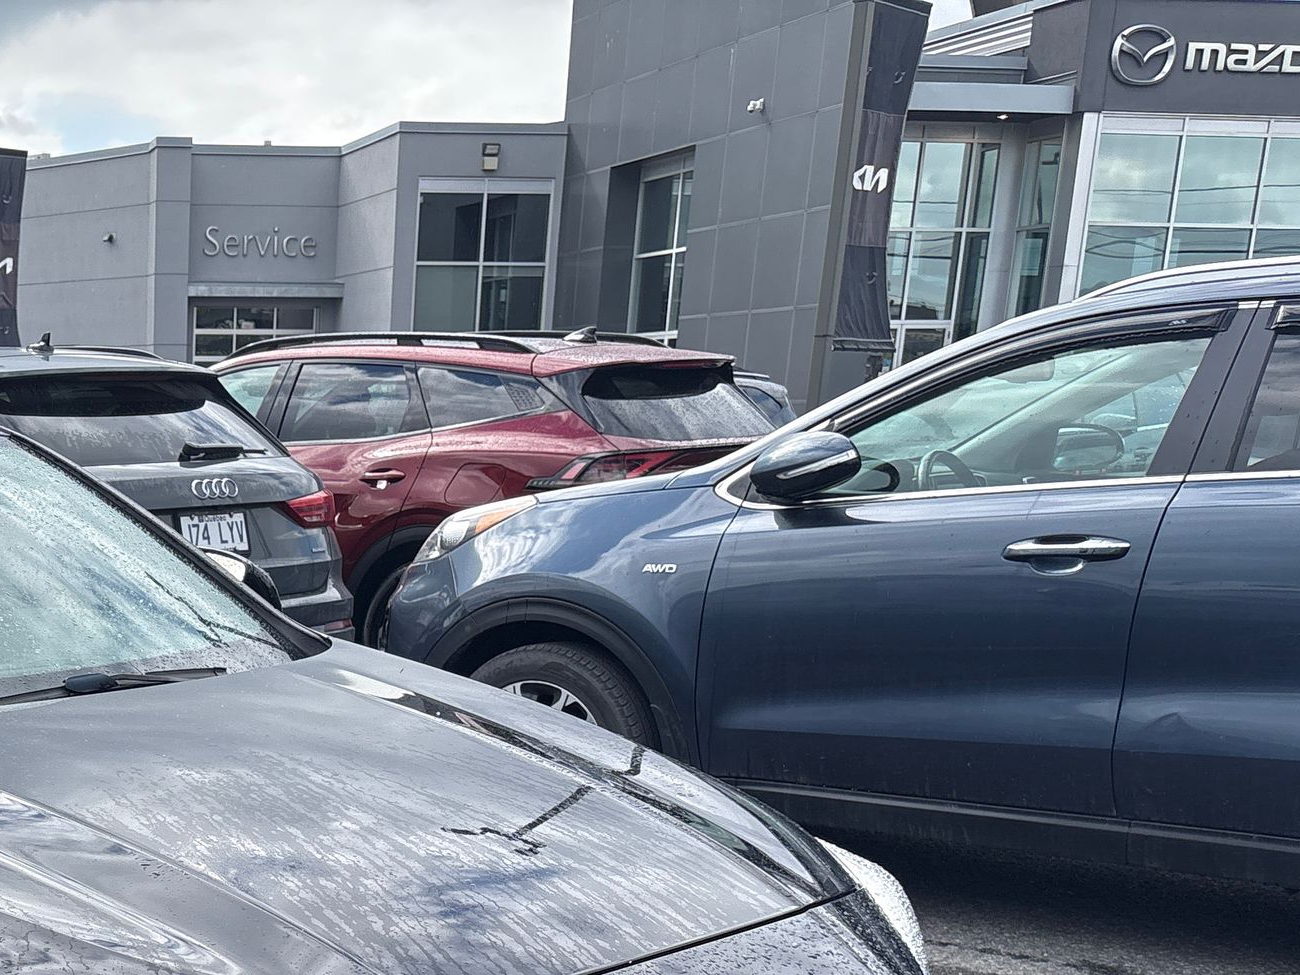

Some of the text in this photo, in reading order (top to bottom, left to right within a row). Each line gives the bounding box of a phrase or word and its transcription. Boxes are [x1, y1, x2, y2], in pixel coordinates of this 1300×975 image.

[203, 226, 317, 258] Service
[218, 520, 244, 544] LYV
[642, 563, 677, 574] AWD
